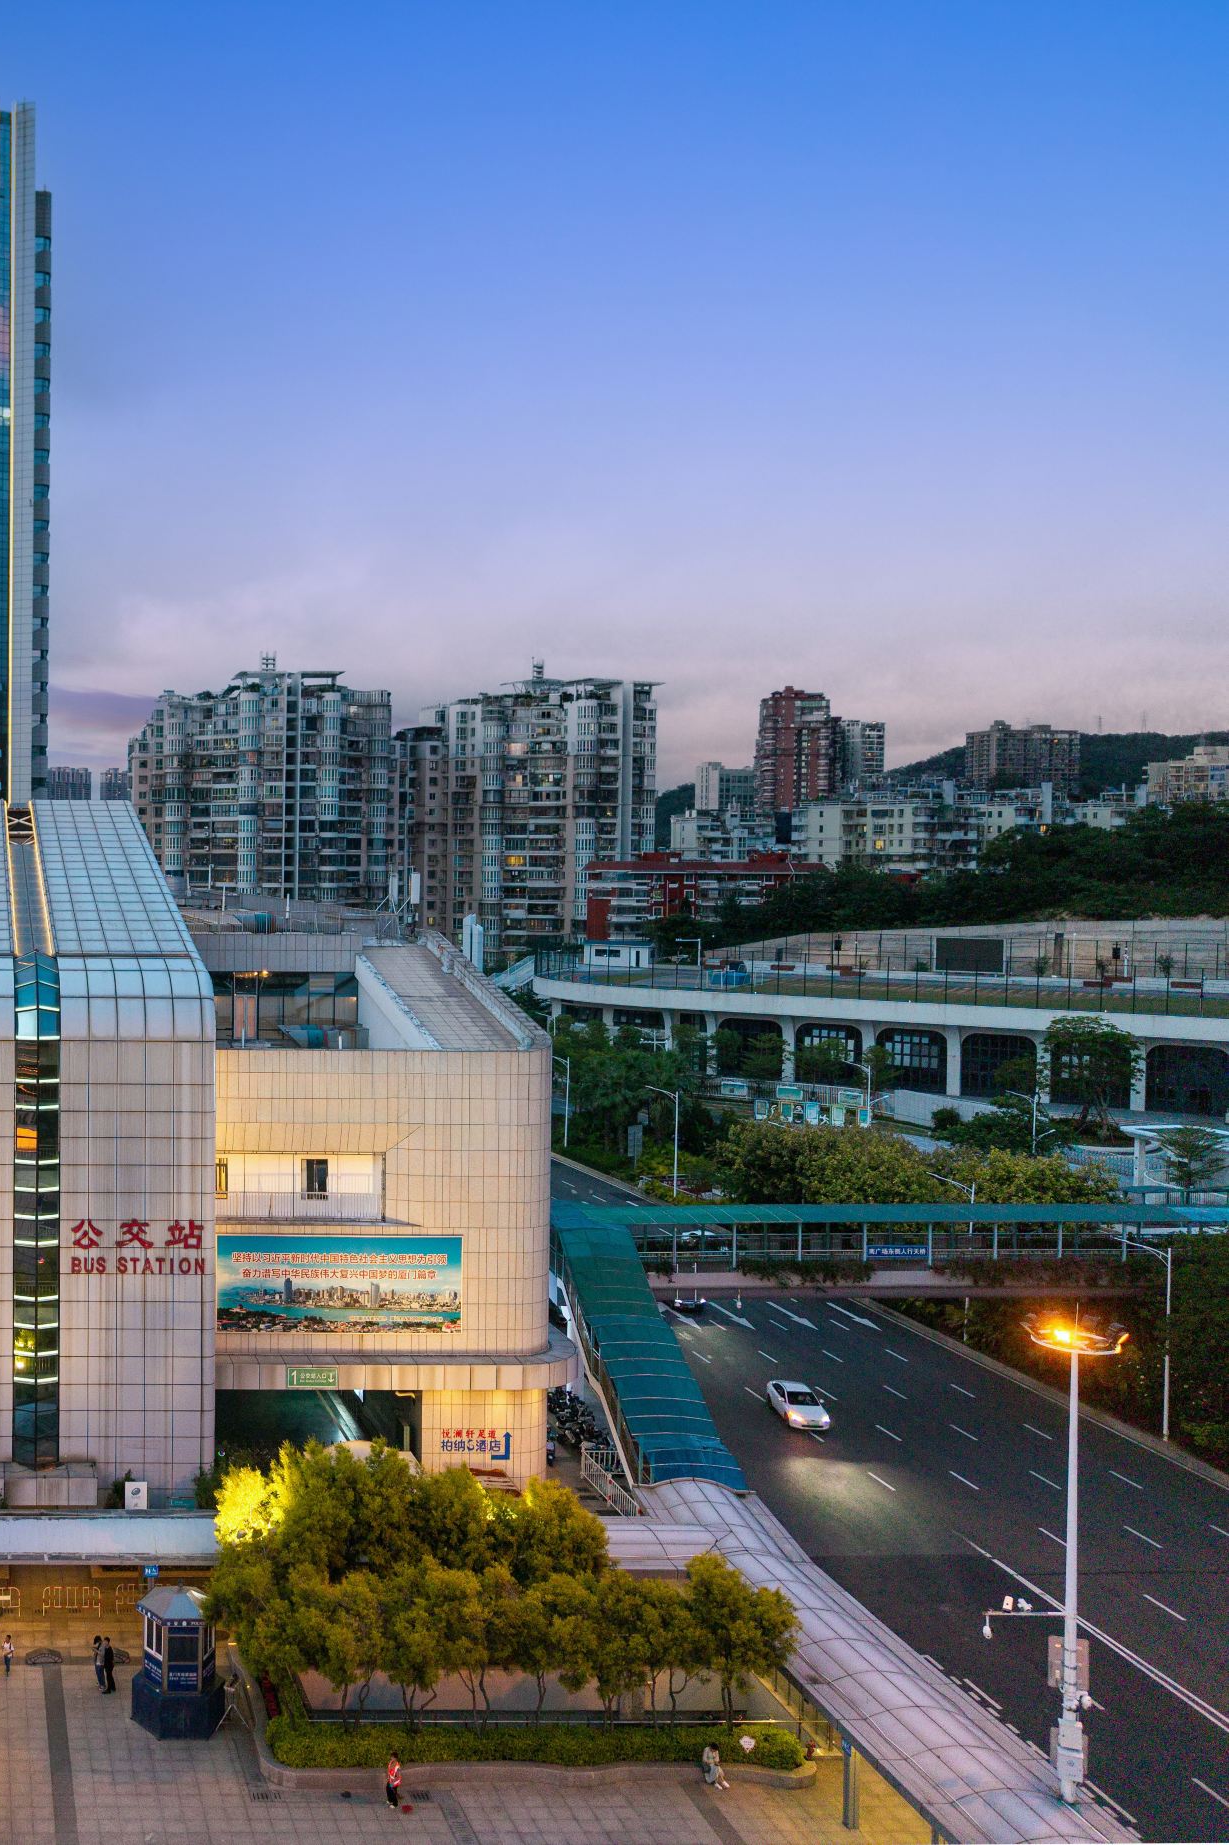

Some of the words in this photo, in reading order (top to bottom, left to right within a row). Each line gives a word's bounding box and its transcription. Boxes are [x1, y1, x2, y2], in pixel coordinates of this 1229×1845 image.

[71, 1218, 203, 1249] 公交站
[71, 1256, 106, 1275] BUS
[117, 1256, 204, 1275] STATION
[232, 1252, 447, 1265] 坚持以习近平新时代中国特色社会主义思想为引领
[242, 1268, 437, 1280] 奋力谱写中华民族伟大复兴中国梦的厦门篇章
[291, 1370, 297, 1385] 1
